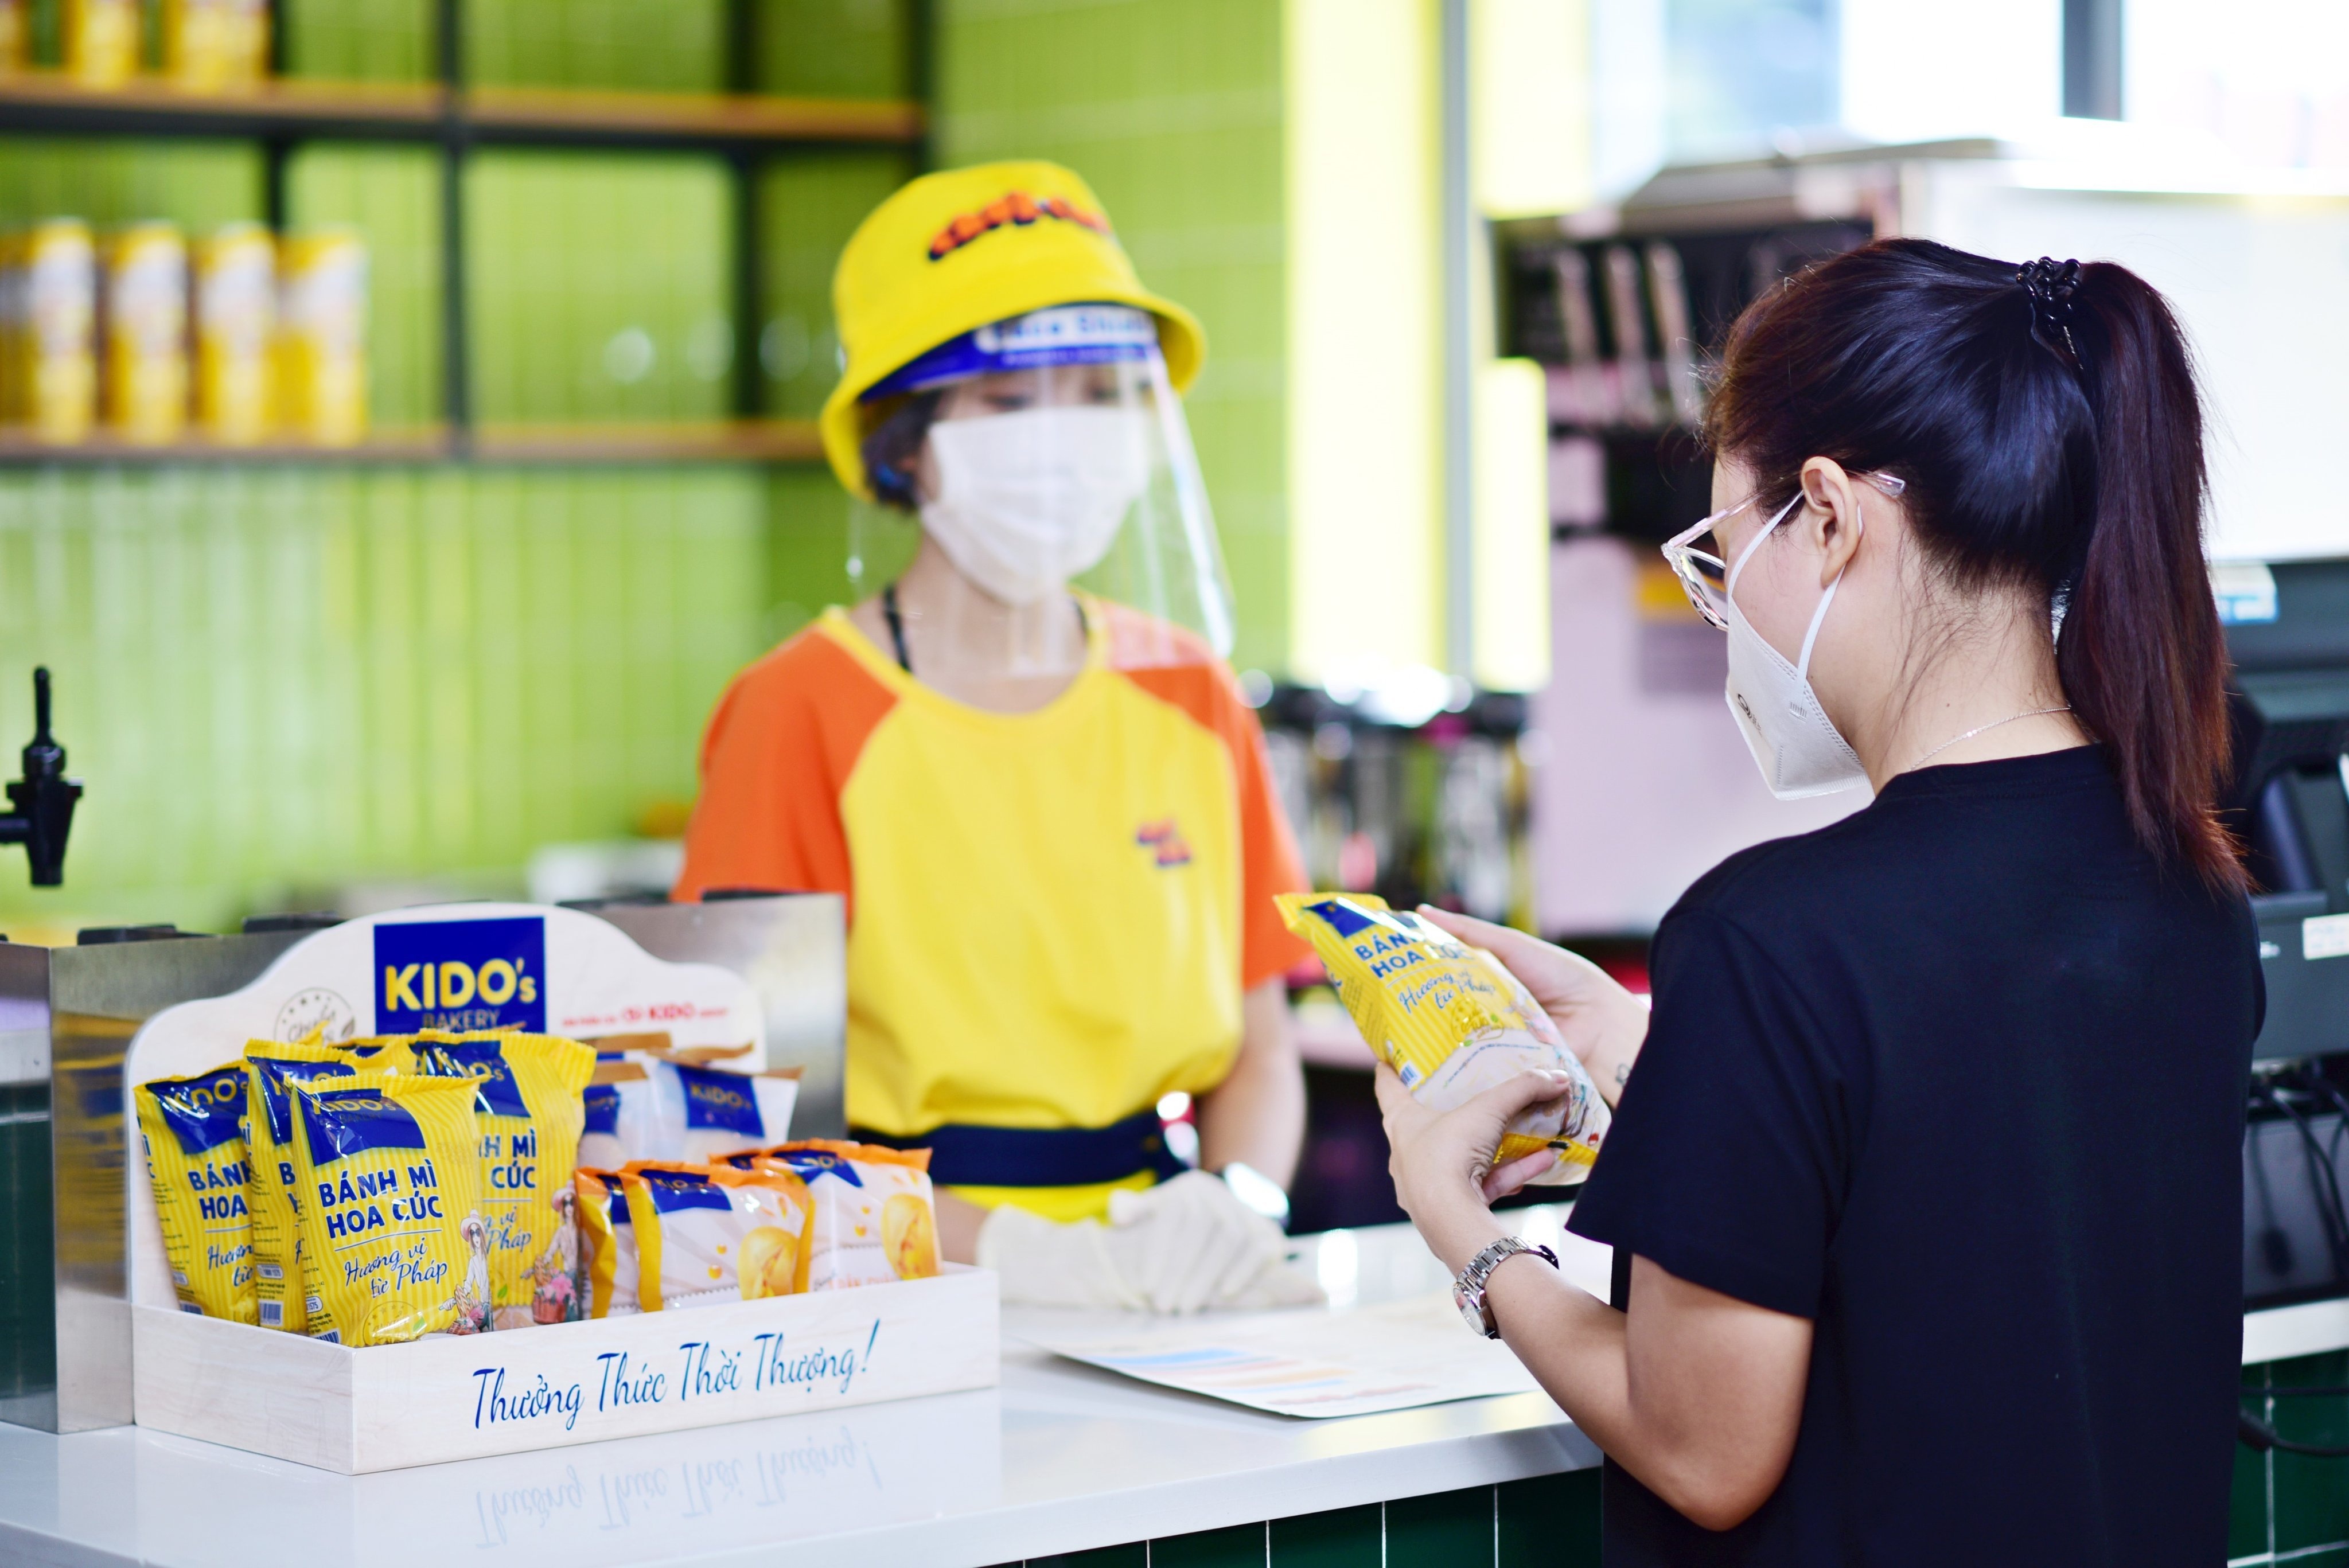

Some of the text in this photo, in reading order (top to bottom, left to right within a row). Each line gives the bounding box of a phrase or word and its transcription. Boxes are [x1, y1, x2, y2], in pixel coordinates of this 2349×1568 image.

[1370, 950, 1425, 978] HOA
[385, 957, 537, 1011] KIDO's
[422, 1008, 501, 1031] BAKERY
[512, 1128, 536, 1159] MÌ
[318, 1170, 398, 1207] BÁNH
[407, 1159, 437, 1188] MÌ
[490, 1160, 536, 1189] CÚC
[198, 1194, 248, 1220] HOA
[326, 1205, 385, 1239] HOA
[392, 1191, 443, 1221] CÚC
[344, 1250, 404, 1287] Hương
[408, 1237, 428, 1261] vị
[396, 1259, 448, 1291] Pháp
[473, 1319, 880, 1430] Thưởng Thức Thời Thượng!
